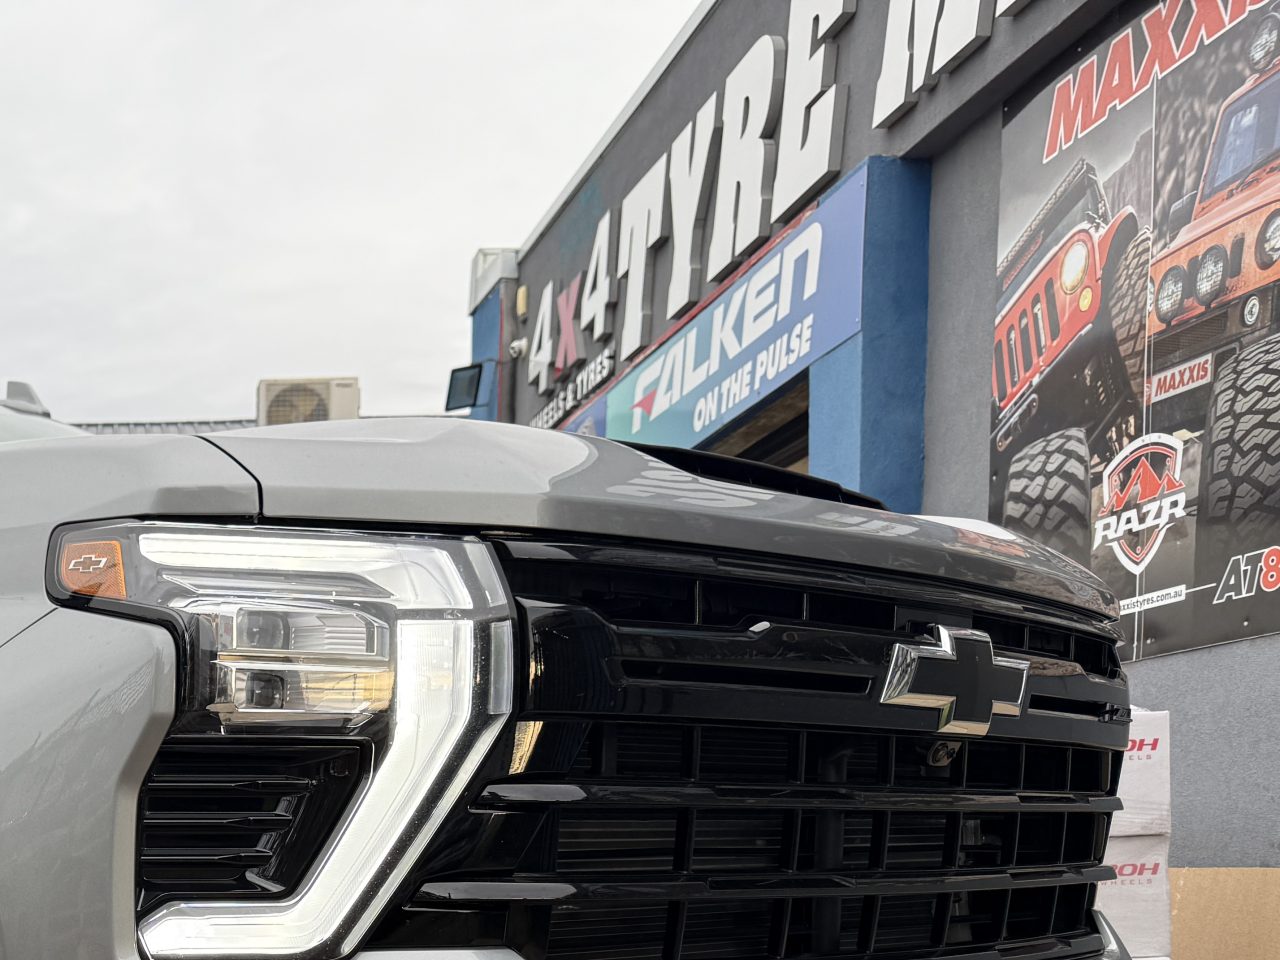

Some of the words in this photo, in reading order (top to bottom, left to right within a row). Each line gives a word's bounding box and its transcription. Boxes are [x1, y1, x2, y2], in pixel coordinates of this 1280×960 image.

[617, 0, 845, 362] TYRE
[631, 222, 823, 434] FALKEN
[576, 348, 611, 400] TYRES
[693, 386, 719, 432] ON
[721, 361, 752, 414] THE
[754, 313, 814, 390] PULSE
[1155, 359, 1210, 397] MAXXIS
[1093, 492, 1187, 550] RAZR
